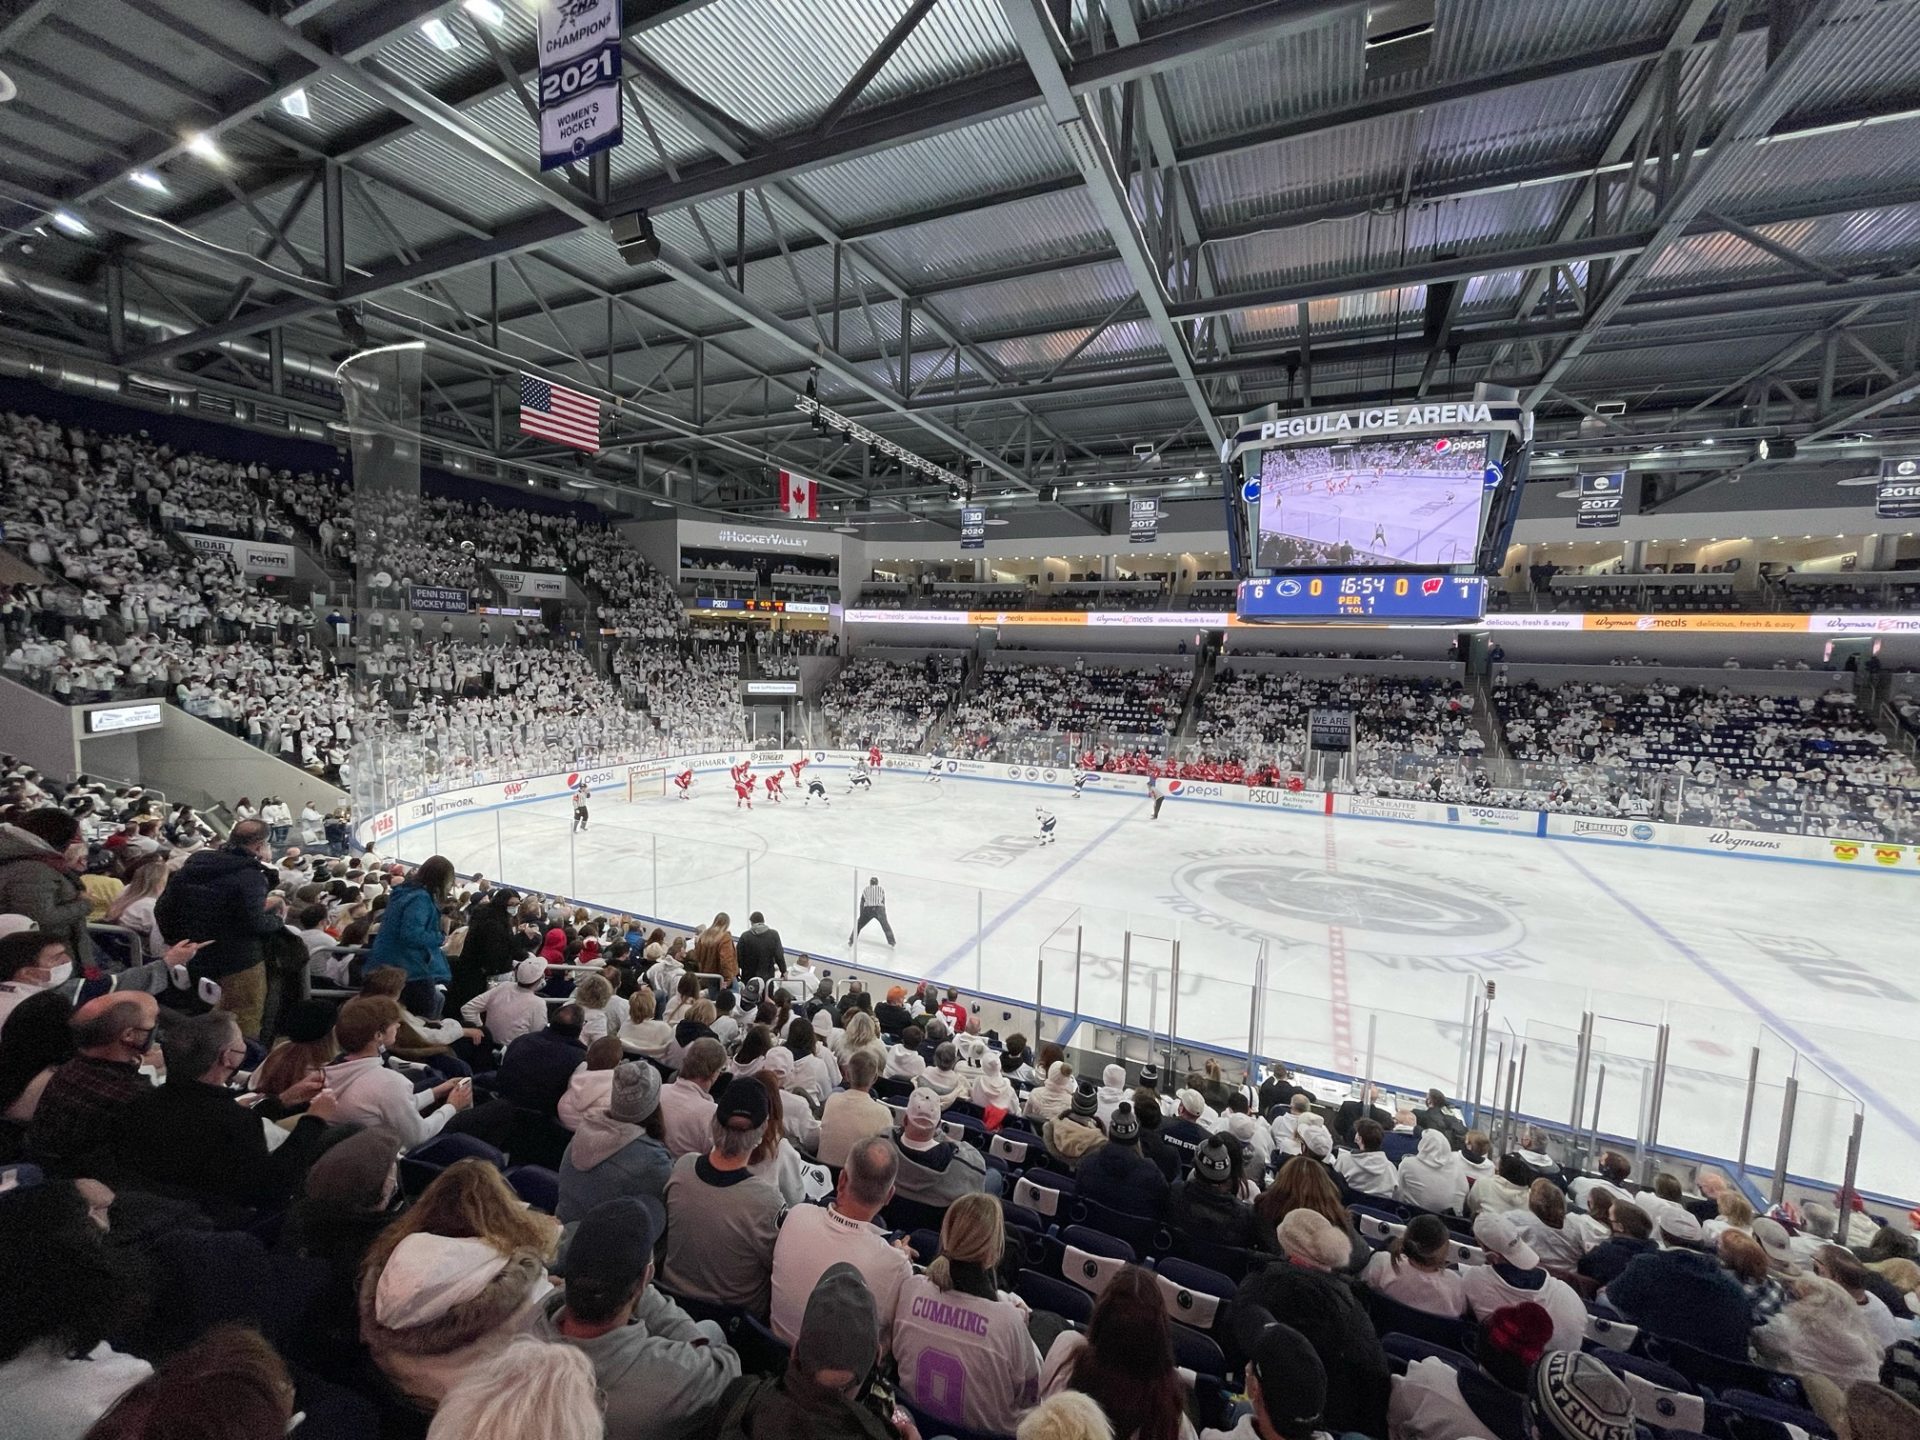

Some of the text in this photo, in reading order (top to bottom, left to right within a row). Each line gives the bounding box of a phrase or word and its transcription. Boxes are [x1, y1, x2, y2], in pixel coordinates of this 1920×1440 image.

[543, 49, 612, 102] 2021
[557, 102, 599, 128] WOMEN'S
[560, 117, 597, 139] HOCKEY
[1260, 403, 1493, 440] PEGULA ICE ARENA
[1452, 438, 1487, 455] pepsi
[1581, 500, 1620, 510] 2017
[1131, 519, 1156, 528] 2017
[961, 528, 984, 536] 2020
[194, 539, 226, 552] ROAR
[249, 554, 287, 565] POINTE
[1249, 578, 1271, 586] SHOTS
[1310, 578, 1323, 597] 0
[1341, 577, 1386, 594] 16:54
[1394, 578, 1409, 596] 0
[416, 589, 462, 601] PENN STATE
[1255, 586, 1264, 599] 6
[1460, 585, 1469, 598] 1
[411, 598, 466, 611] HOCKEY BAND
[712, 600, 728, 608] PSECU
[1338, 596, 1375, 605] PER 1
[1005, 614, 1025, 623] meals
[1096, 615, 1122, 625] Wegmans
[1132, 615, 1154, 624] meals
[1185, 617, 1200, 625] fresh
[1206, 618, 1219, 626] easy
[1486, 619, 1570, 629] delicious, fresh & easy
[1596, 616, 1637, 629] Wegmans
[1654, 617, 1687, 628] meals
[1696, 619, 1737, 629] delicious,
[1739, 619, 1761, 629] fresh
[1764, 620, 1772, 628] &
[1775, 621, 1796, 630] easy
[1826, 617, 1876, 630] Wegmans
[1312, 716, 1349, 726] WE ARE
[583, 769, 614, 785] pepsi
[1187, 782, 1223, 798] pepsi
[1249, 790, 1279, 805] PSECU
[1282, 796, 1315, 804] Achieve
[436, 797, 474, 813] NETWORK
[1376, 798, 1417, 811] SHEAFFER
[1632, 802, 1643, 811] 31
[1352, 806, 1416, 820] ENGINEERING
[1575, 820, 1588, 831] ICE
[1588, 822, 1628, 836] BREAKERS
[1707, 831, 1781, 851] Wegmans
[1164, 1134, 1200, 1152] PENN STA
[911, 1296, 989, 1338] CUMMING
